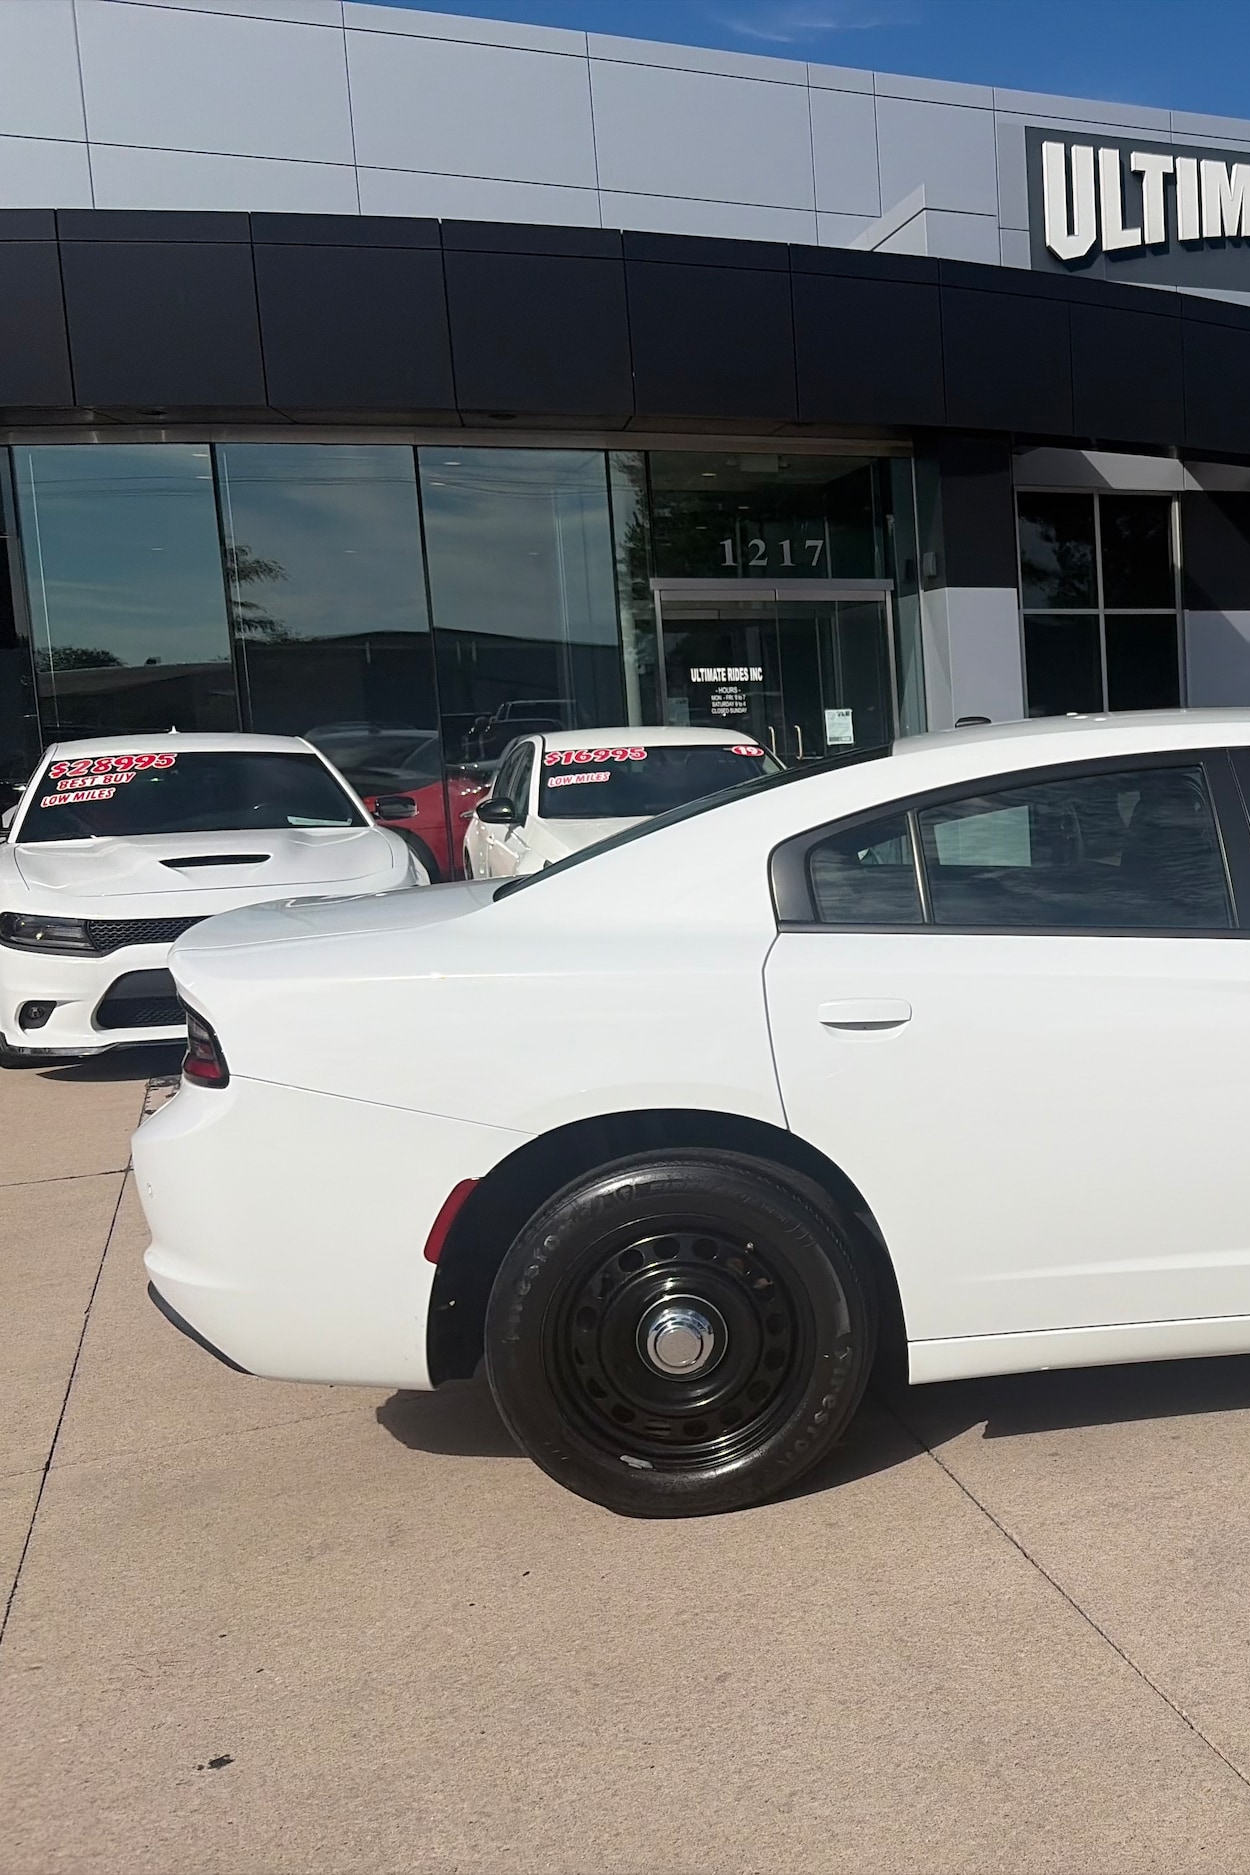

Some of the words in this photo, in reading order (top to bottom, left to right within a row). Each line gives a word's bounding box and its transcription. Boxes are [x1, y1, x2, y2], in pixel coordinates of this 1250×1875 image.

[719, 538, 824, 567] 1217
[690, 667, 727, 683] ULTIMATE
[727, 667, 749, 682] RIDES
[749, 667, 763, 682] INC
[718, 686, 738, 694] HOURS
[49, 753, 177, 778] $28995
[544, 747, 648, 767] $16995
[57, 775, 99, 791] BEST
[102, 772, 137, 784] BUY
[548, 776, 573, 788] LOW
[574, 772, 611, 784] MILES
[41, 793, 72, 808] LOW
[73, 787, 117, 802] MILES
